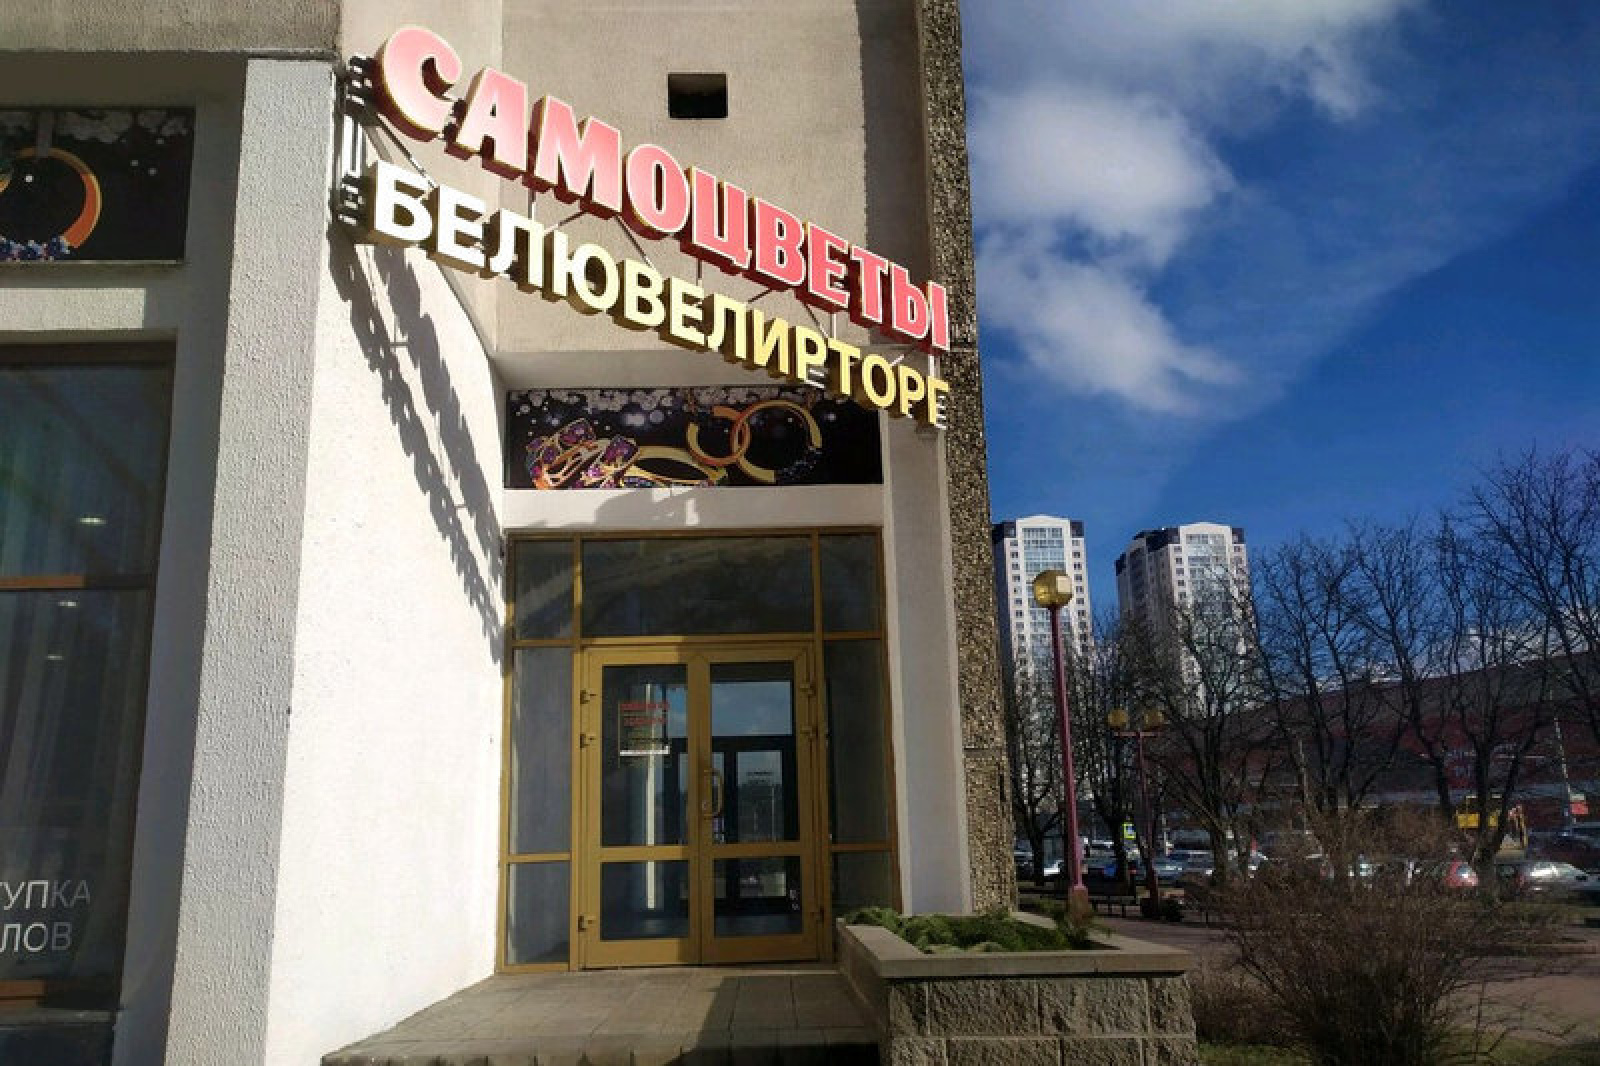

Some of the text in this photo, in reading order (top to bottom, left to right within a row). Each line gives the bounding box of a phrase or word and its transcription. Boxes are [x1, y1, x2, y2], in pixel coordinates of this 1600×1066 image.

[377, 25, 950, 351] САМОЦВЕТЫ
[370, 160, 950, 426] БЕЛЮВЕЛИРТОРГ
[0, 880, 91, 911] УПКА
[0, 921, 73, 953] ЛОВ
